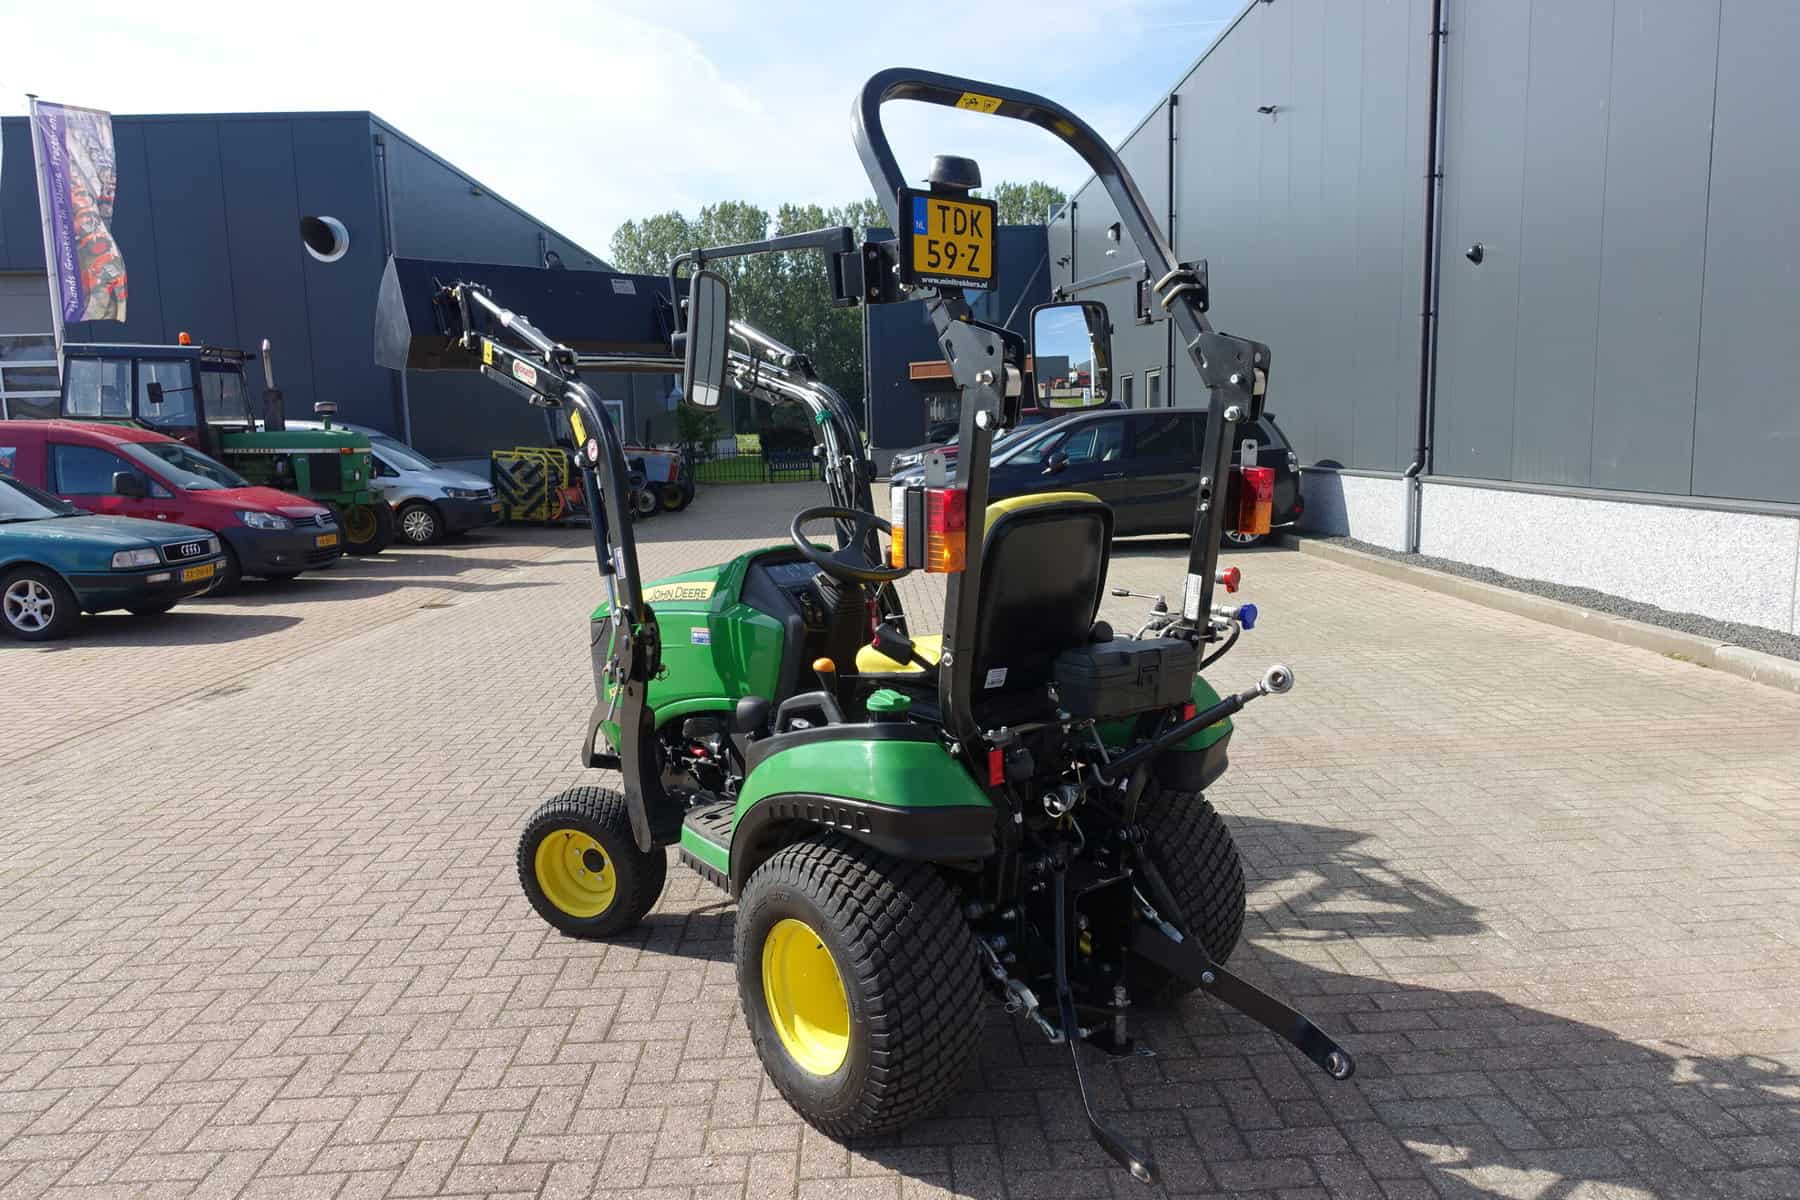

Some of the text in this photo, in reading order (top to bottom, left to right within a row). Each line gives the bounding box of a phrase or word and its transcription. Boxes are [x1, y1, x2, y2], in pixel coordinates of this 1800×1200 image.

[937, 205, 983, 238] TDK
[649, 586, 708, 600] JOHN DEERE
